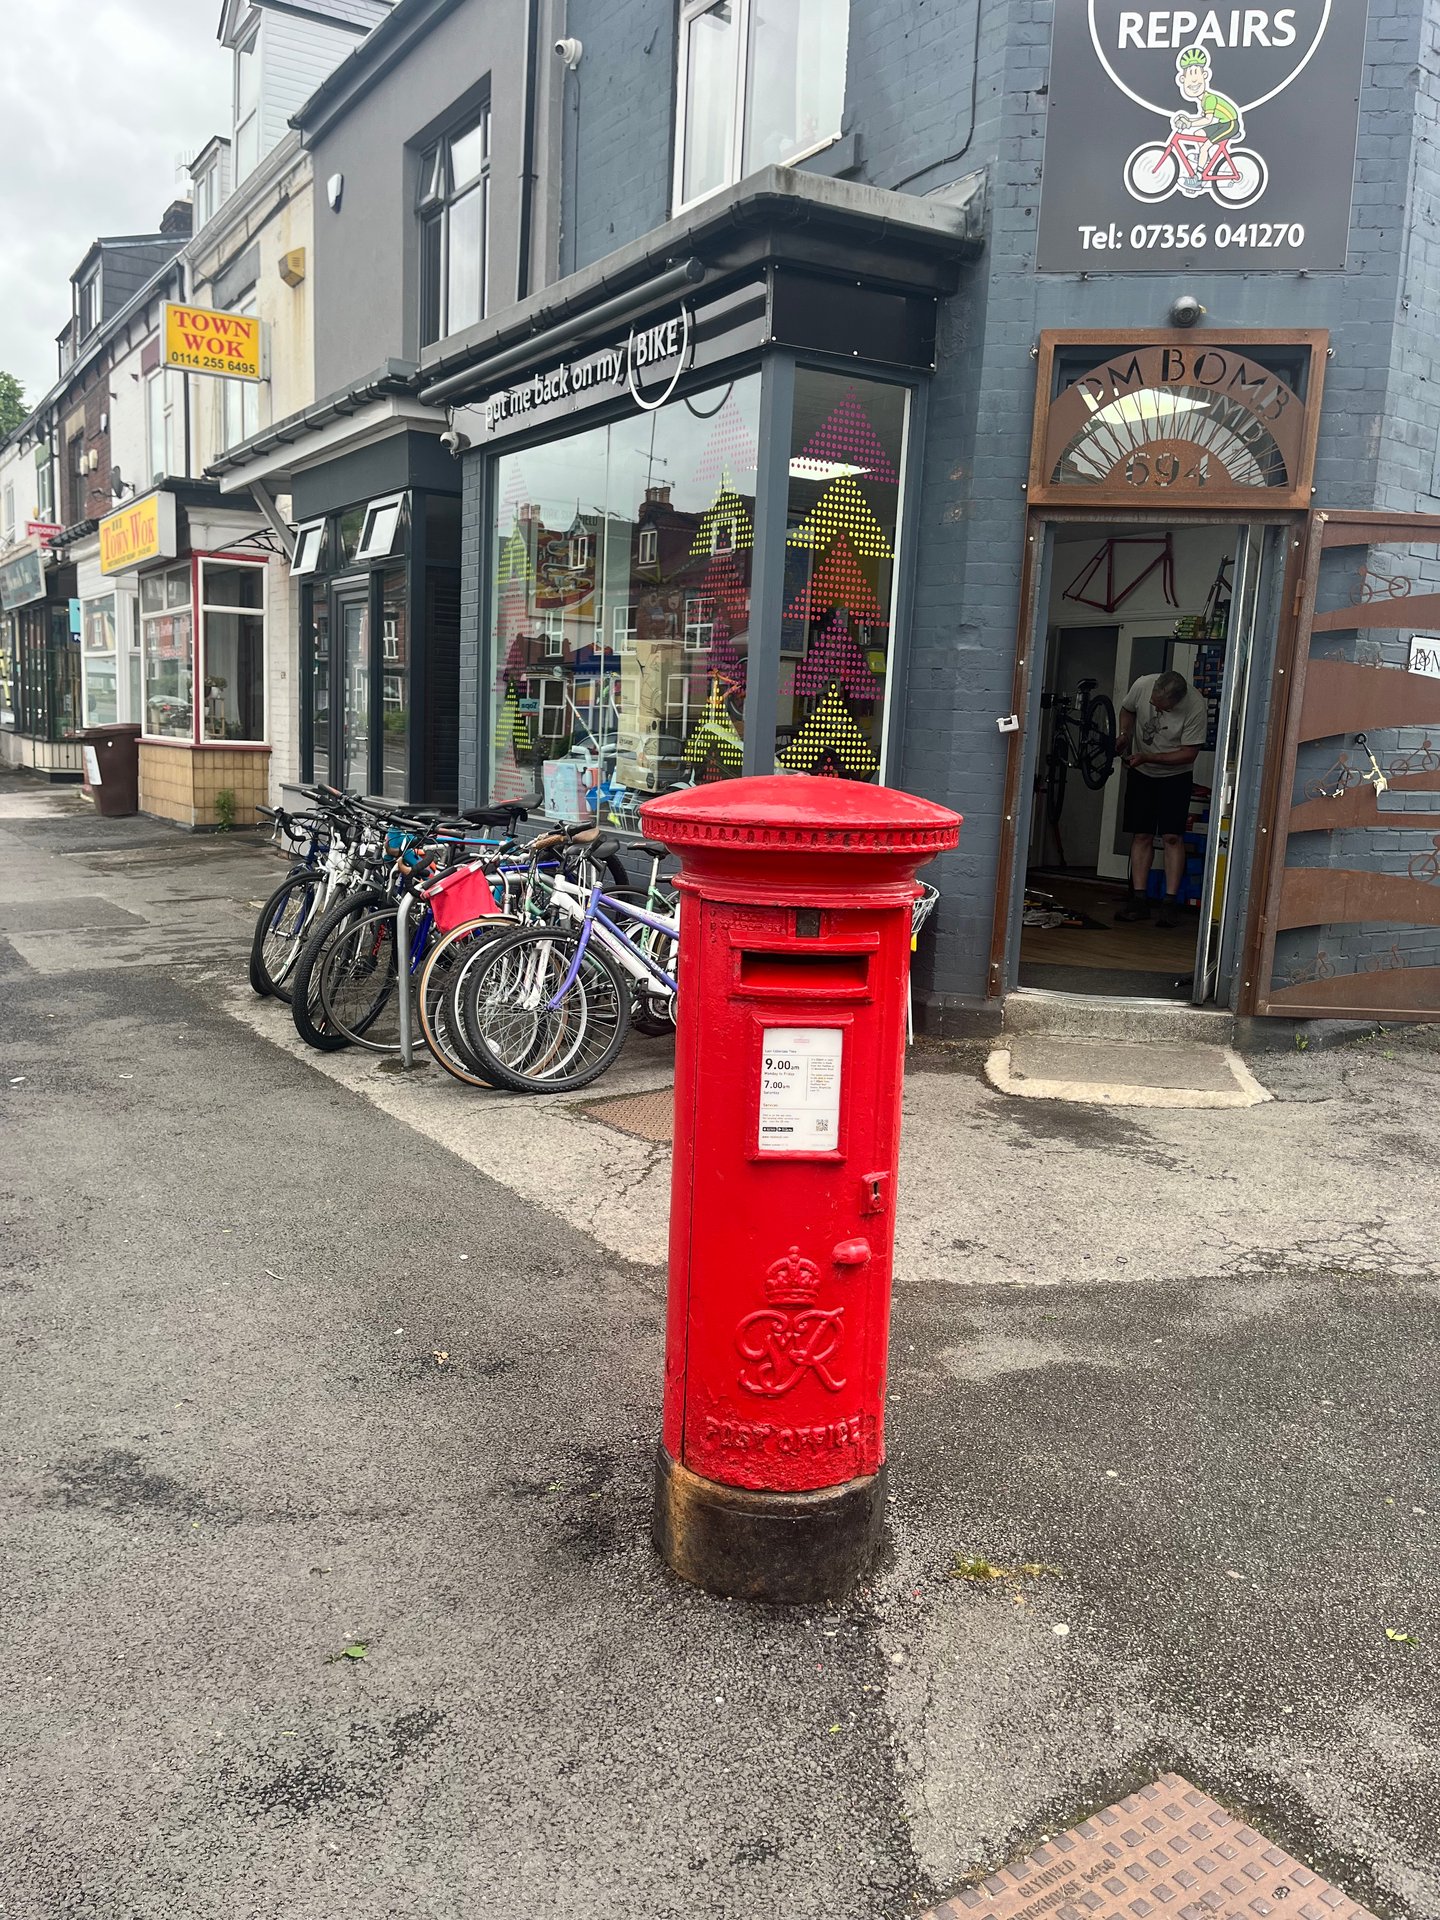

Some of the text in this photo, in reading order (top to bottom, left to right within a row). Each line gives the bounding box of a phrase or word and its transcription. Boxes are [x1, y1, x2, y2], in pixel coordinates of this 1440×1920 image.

[1117, 9, 1297, 49] REPAIRS
[1078, 223, 1305, 250] Tel: 07356 041270
[173, 310, 252, 339] TOWN
[182, 332, 244, 358] WOK
[171, 352, 255, 374] 0114 255 6495
[485, 319, 678, 431] put me back on my BIKE
[1161, 348, 1290, 420] BOMB
[1125, 452, 1213, 487] 694
[1018, 1859, 1077, 1898] GLYNWED
